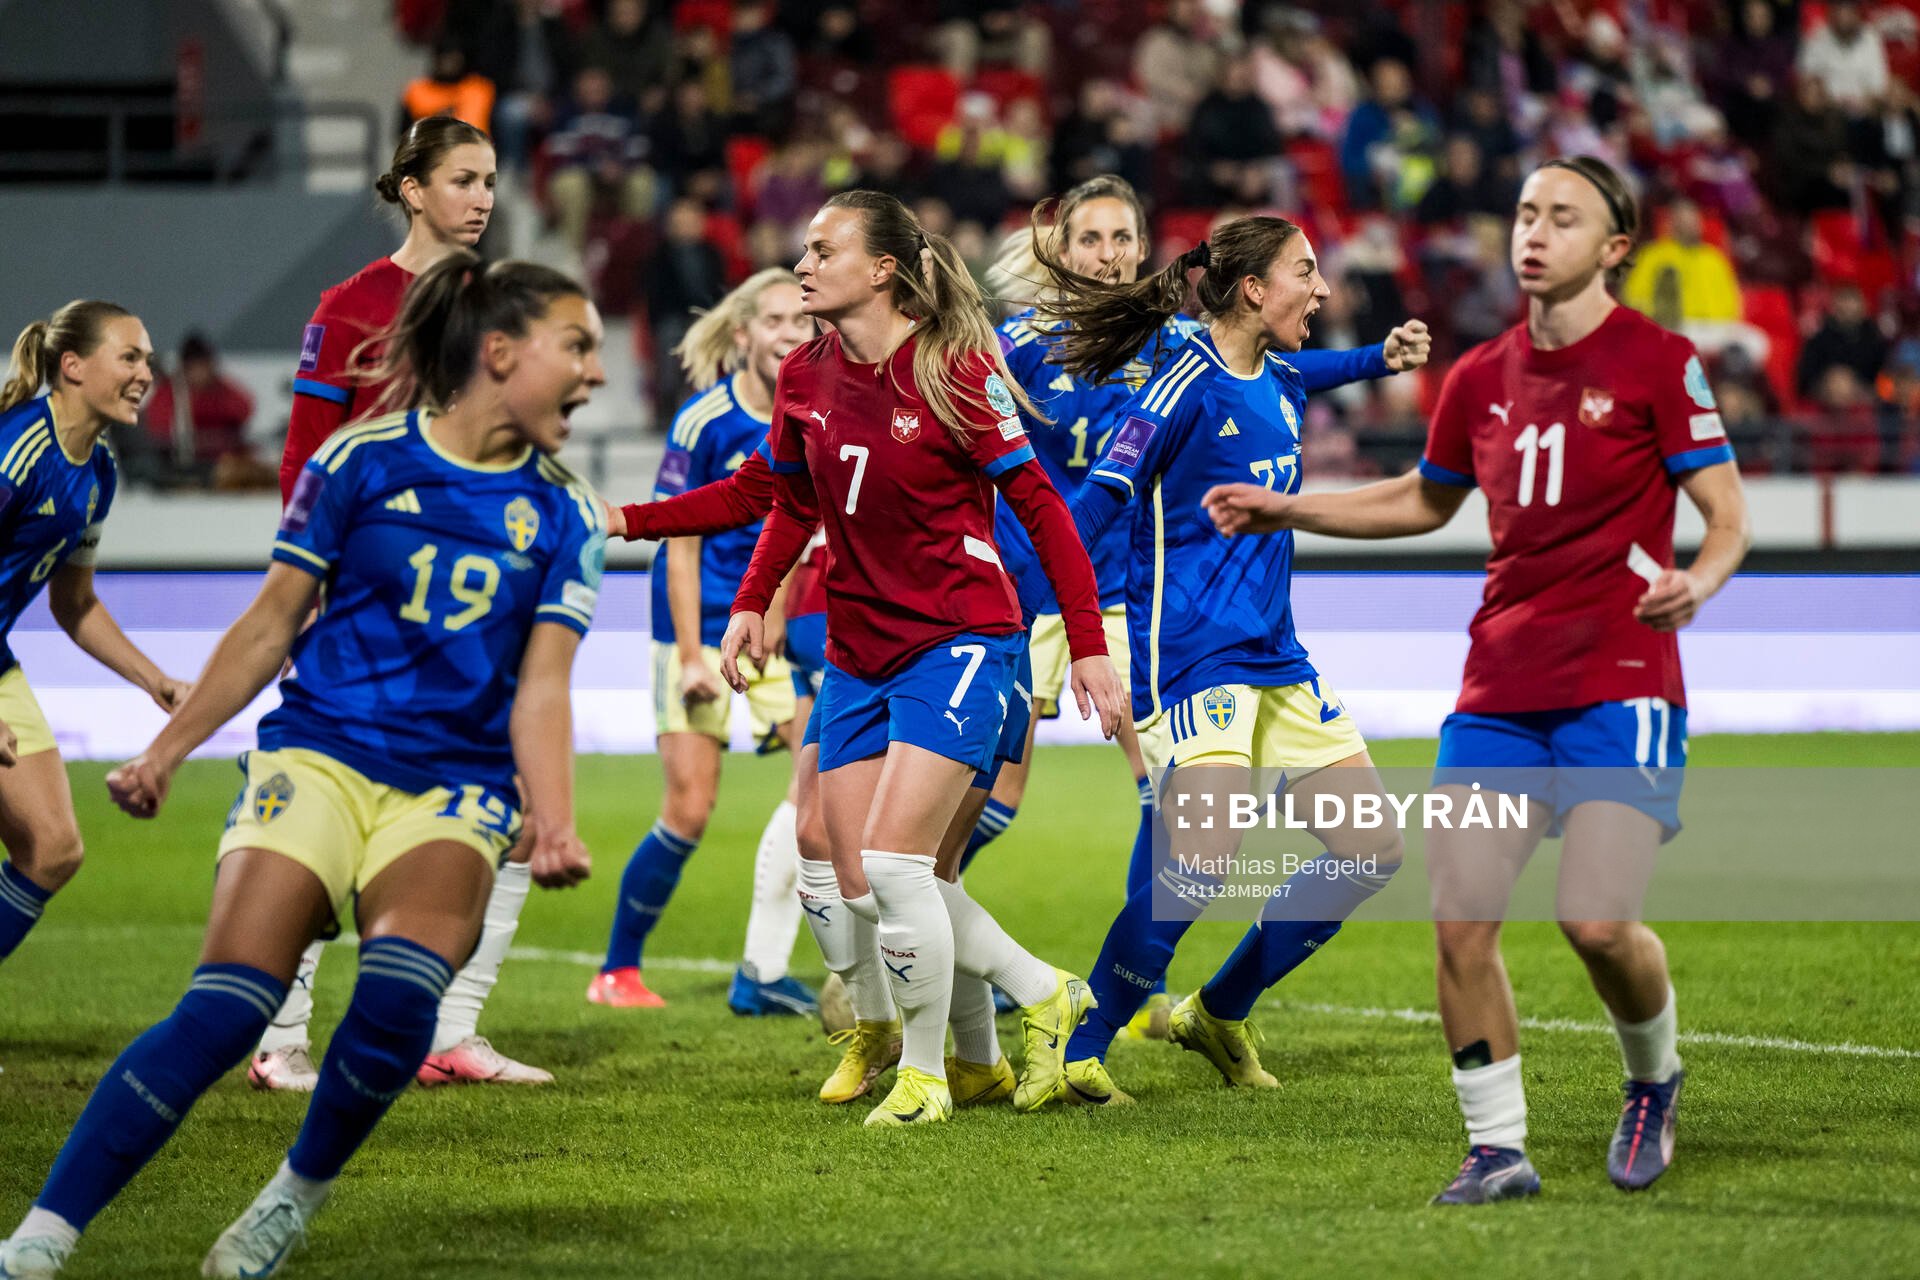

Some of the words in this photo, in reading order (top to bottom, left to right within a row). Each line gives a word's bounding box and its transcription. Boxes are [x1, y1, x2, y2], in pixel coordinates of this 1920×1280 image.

[1067, 417, 1113, 467] 1
[1514, 422, 1566, 507] 11
[839, 445, 869, 515] 7
[29, 538, 67, 583] 6
[399, 543, 500, 631] 19
[950, 645, 986, 708] 7
[1622, 697, 1670, 769] 11
